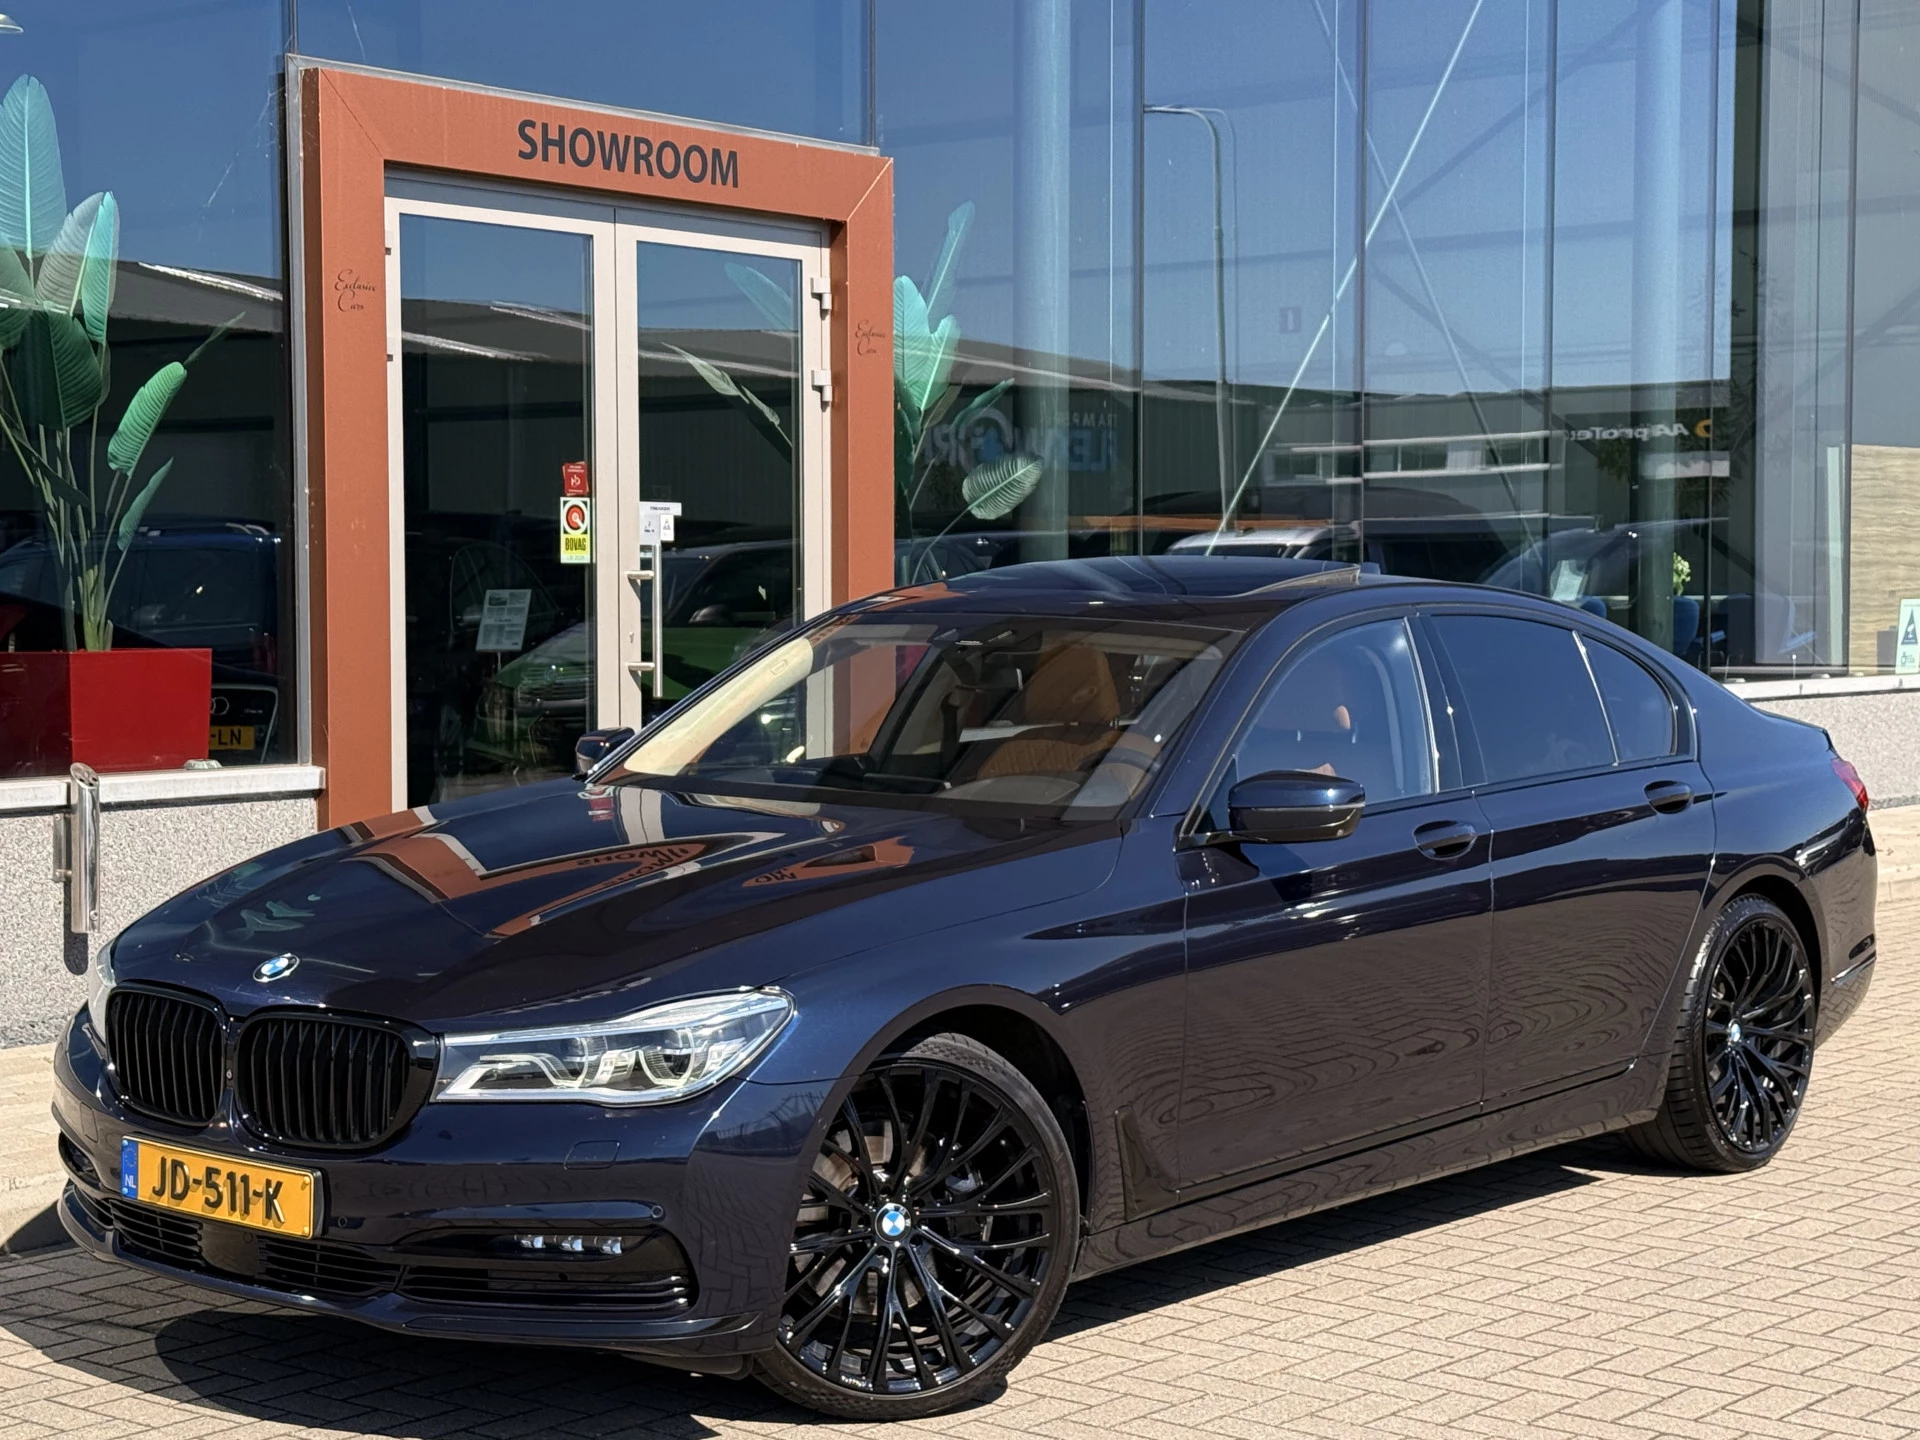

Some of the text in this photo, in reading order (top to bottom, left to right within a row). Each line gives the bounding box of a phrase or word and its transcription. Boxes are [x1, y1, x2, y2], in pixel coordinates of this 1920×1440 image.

[518, 119, 739, 188] SHOWROOM
[337, 289, 364, 312] Cars
[565, 537, 587, 551] BOVAG
[211, 728, 242, 746] -LN
[124, 1174, 137, 1189] NL
[152, 1155, 285, 1224] JD-511-K
